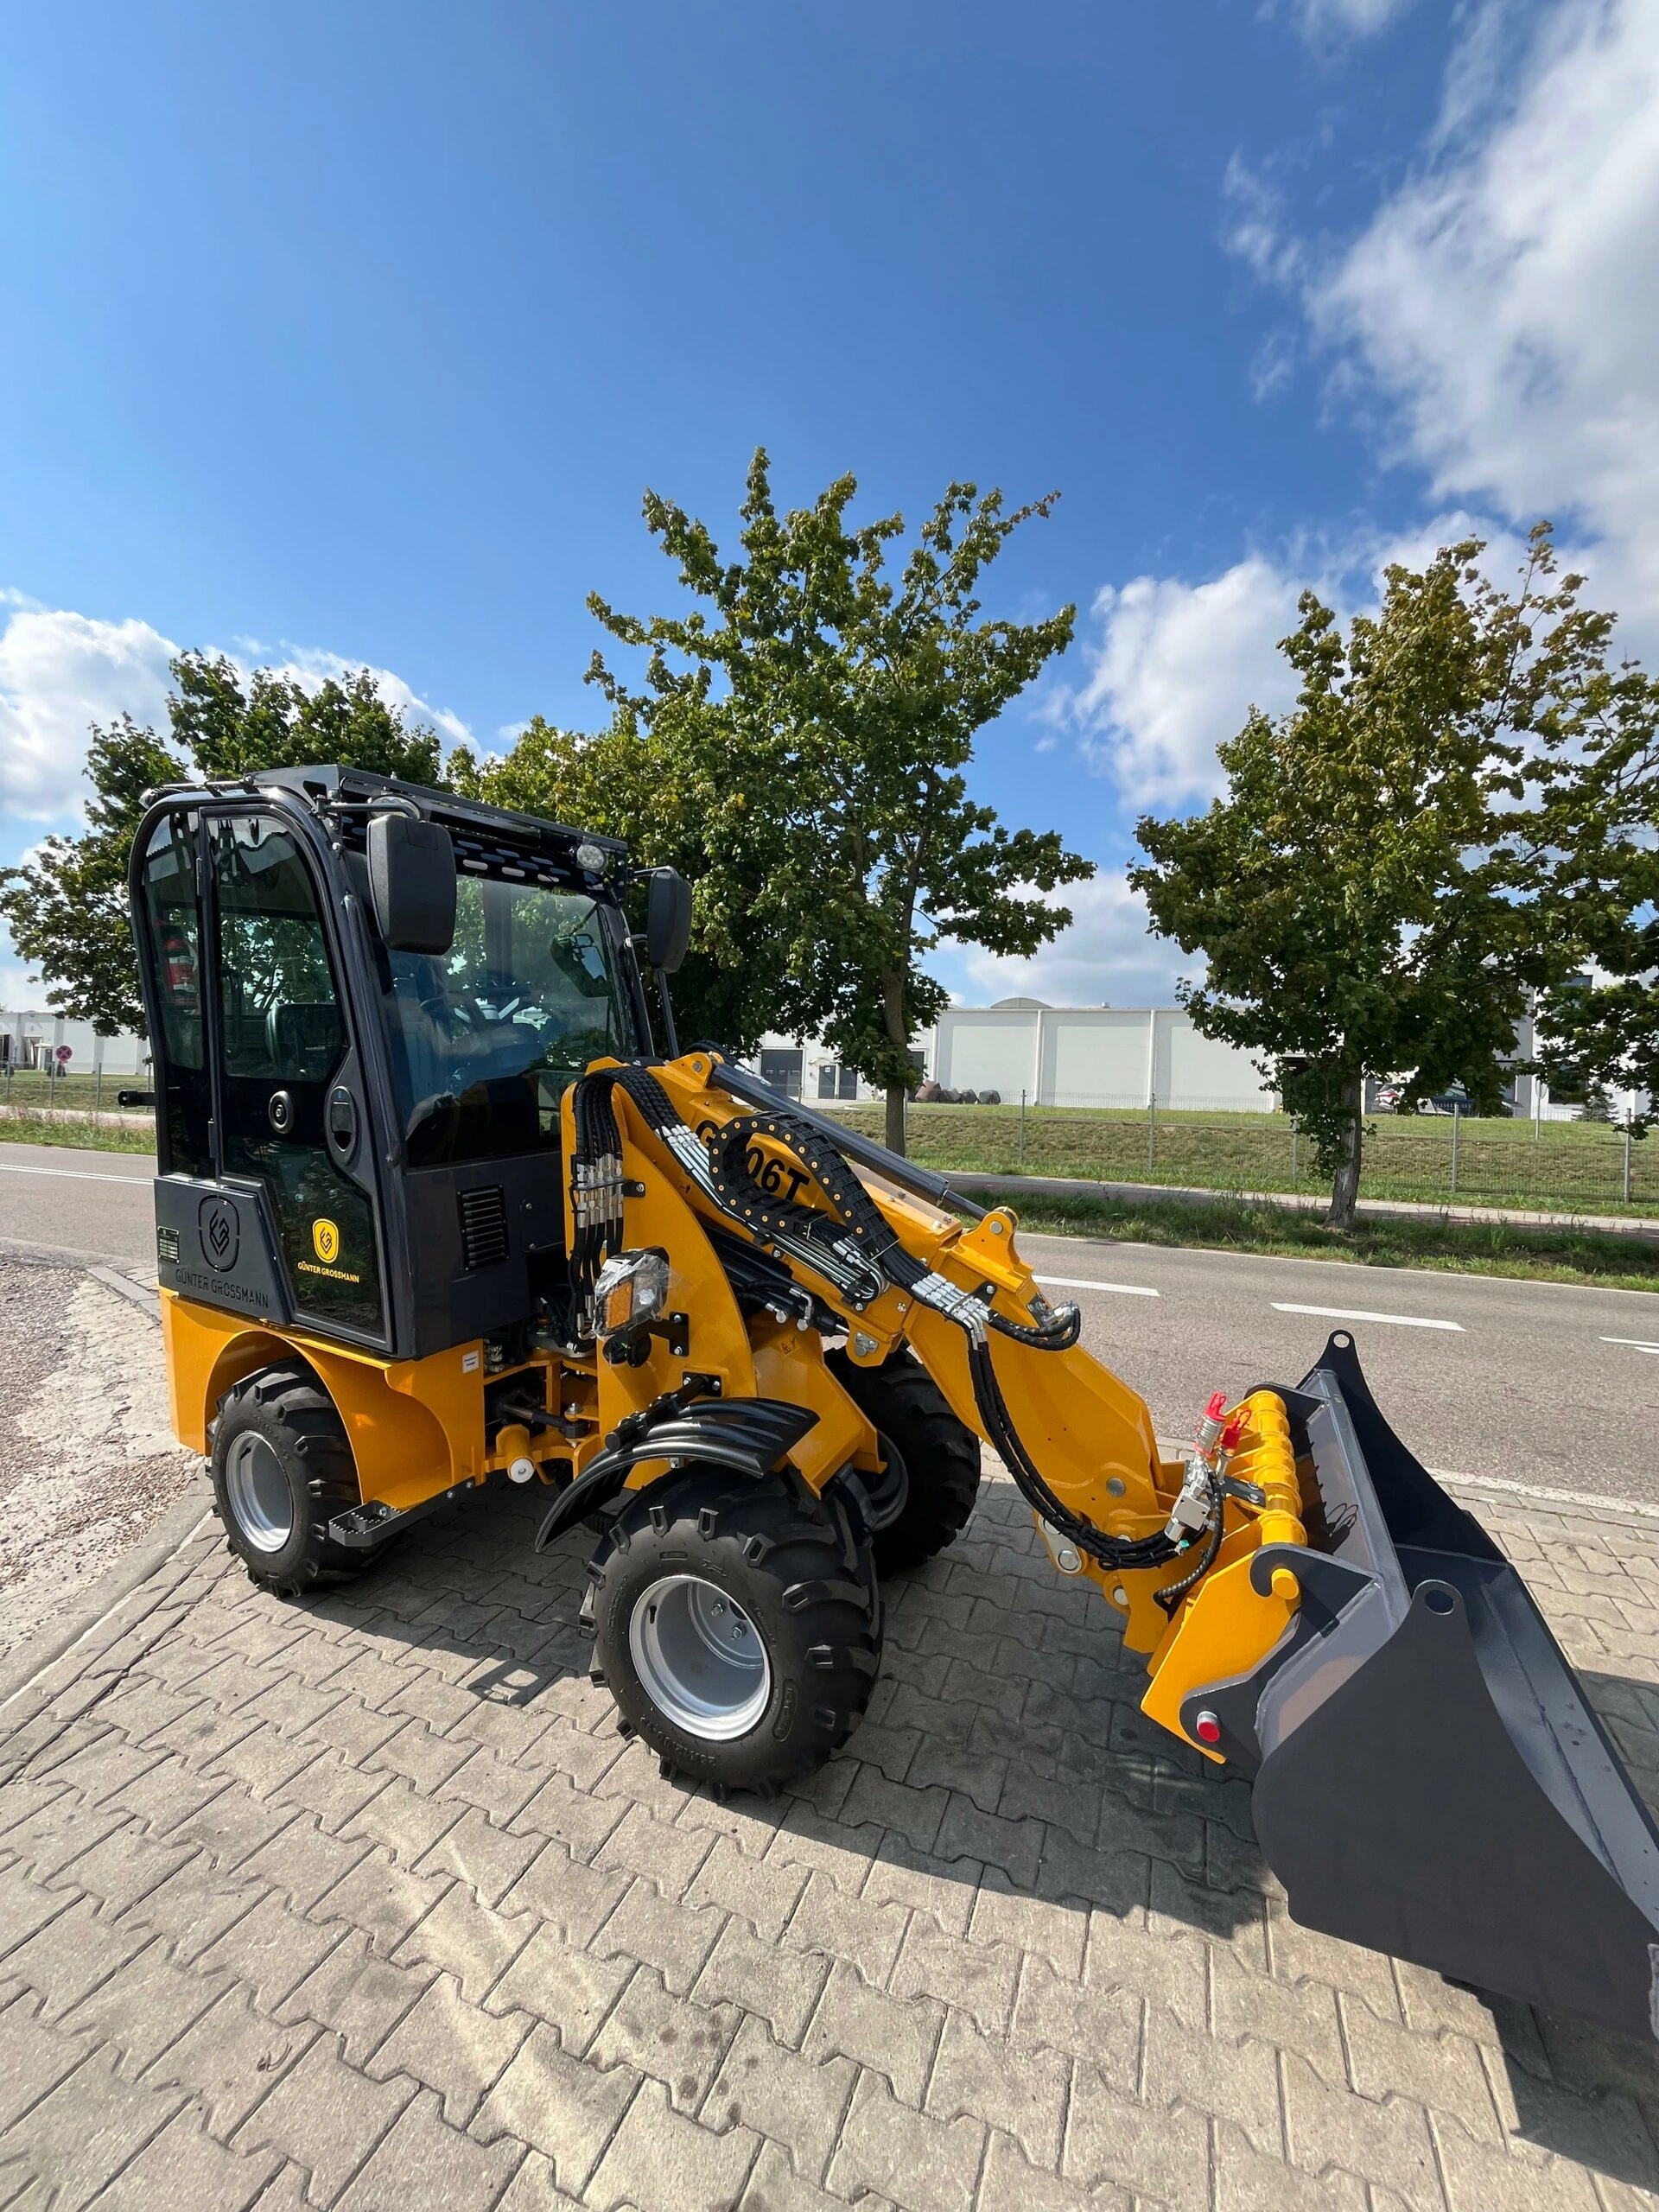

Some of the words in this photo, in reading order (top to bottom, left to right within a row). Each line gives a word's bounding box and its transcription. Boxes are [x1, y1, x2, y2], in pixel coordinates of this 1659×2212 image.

[297, 1261, 321, 1274] GÜNTER
[321, 1267, 359, 1283] GROSSMANN
[175, 1268, 208, 1290] GÜNTER
[211, 1279, 269, 1308] GROSSMANN
